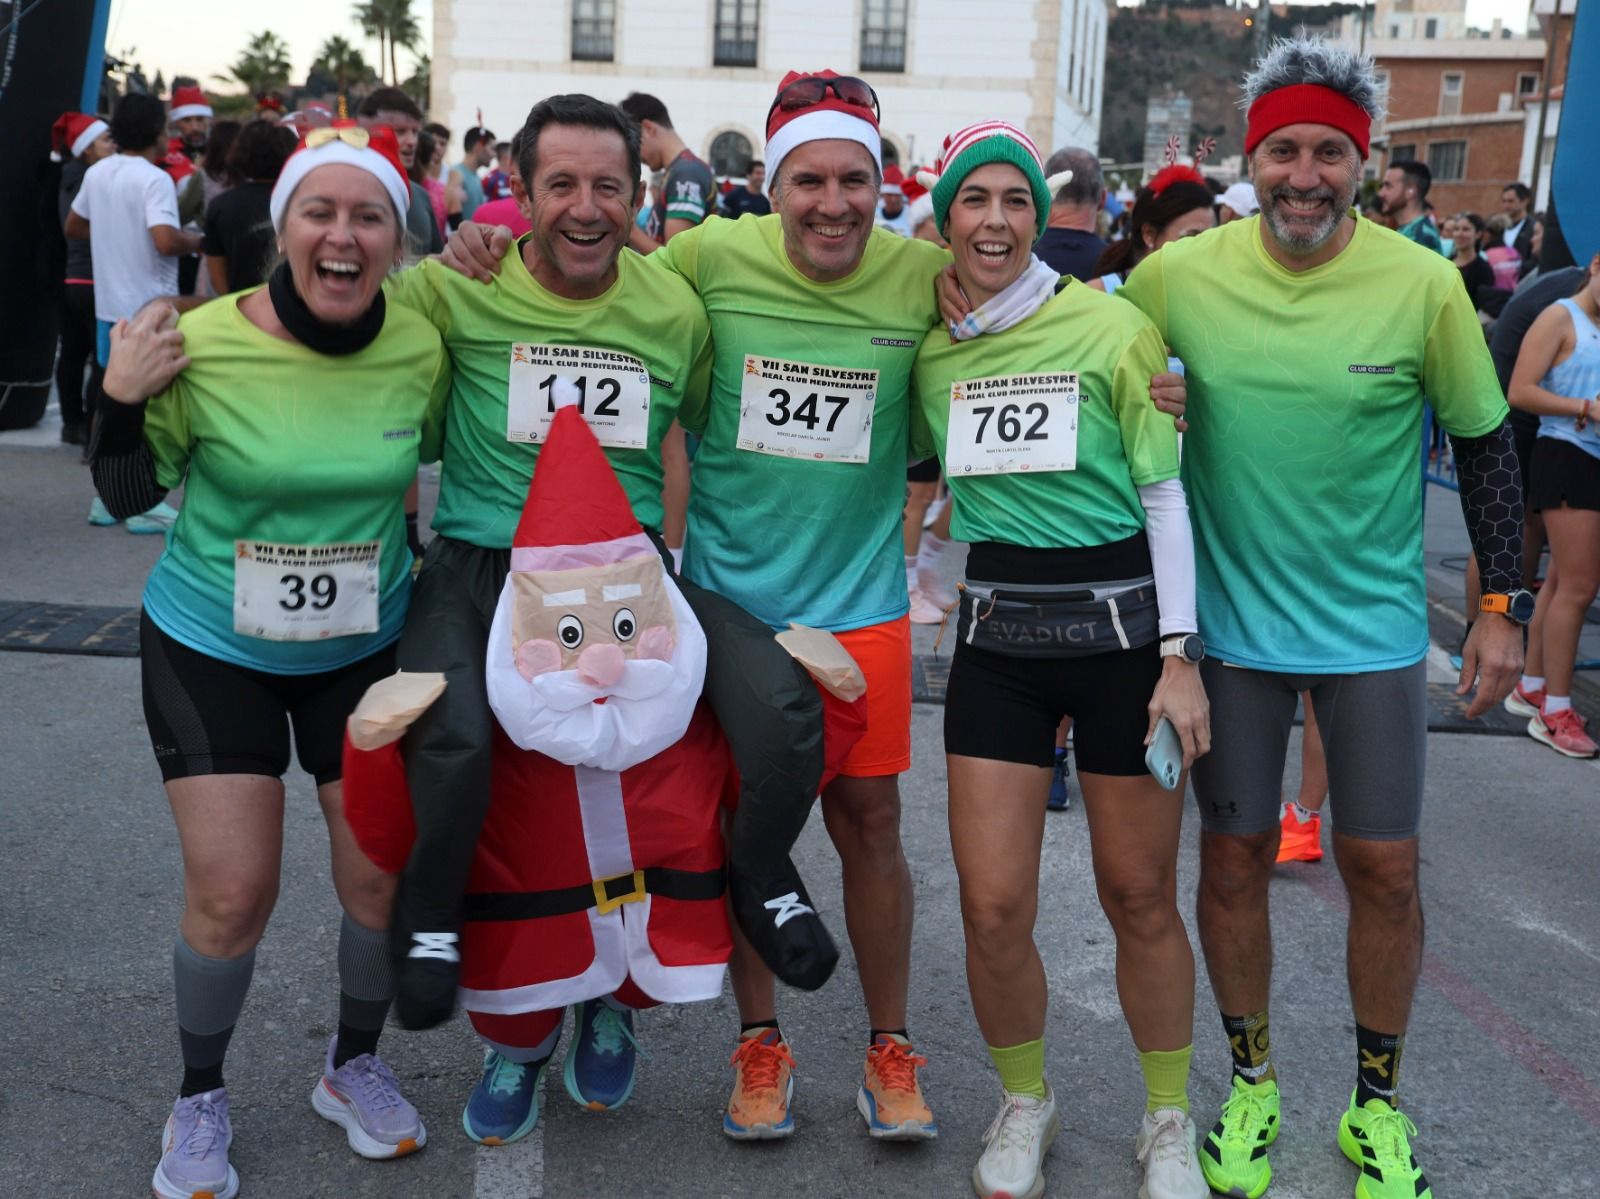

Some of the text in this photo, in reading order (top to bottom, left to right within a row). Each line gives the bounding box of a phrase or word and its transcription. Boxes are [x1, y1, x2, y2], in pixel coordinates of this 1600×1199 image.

[530, 346, 643, 367] VII SAN SILVESTRE
[531, 358, 554, 366] REAL
[556, 360, 579, 368] CLUB
[762, 360, 877, 381] VII SAN SILVESTRE
[762, 371, 784, 381] REAL
[786, 375, 808, 384] CLUB
[966, 375, 1077, 391] VII SAN SILVESTRE
[539, 373, 621, 417] 112
[967, 393, 987, 401] REAL
[988, 390, 1008, 398] CLUB
[765, 388, 850, 432] 347
[972, 402, 1049, 444] 762
[255, 544, 274, 554] VII
[278, 547, 307, 558] SAN
[279, 573, 338, 613] 39
[989, 620, 1097, 643] EVADICT
